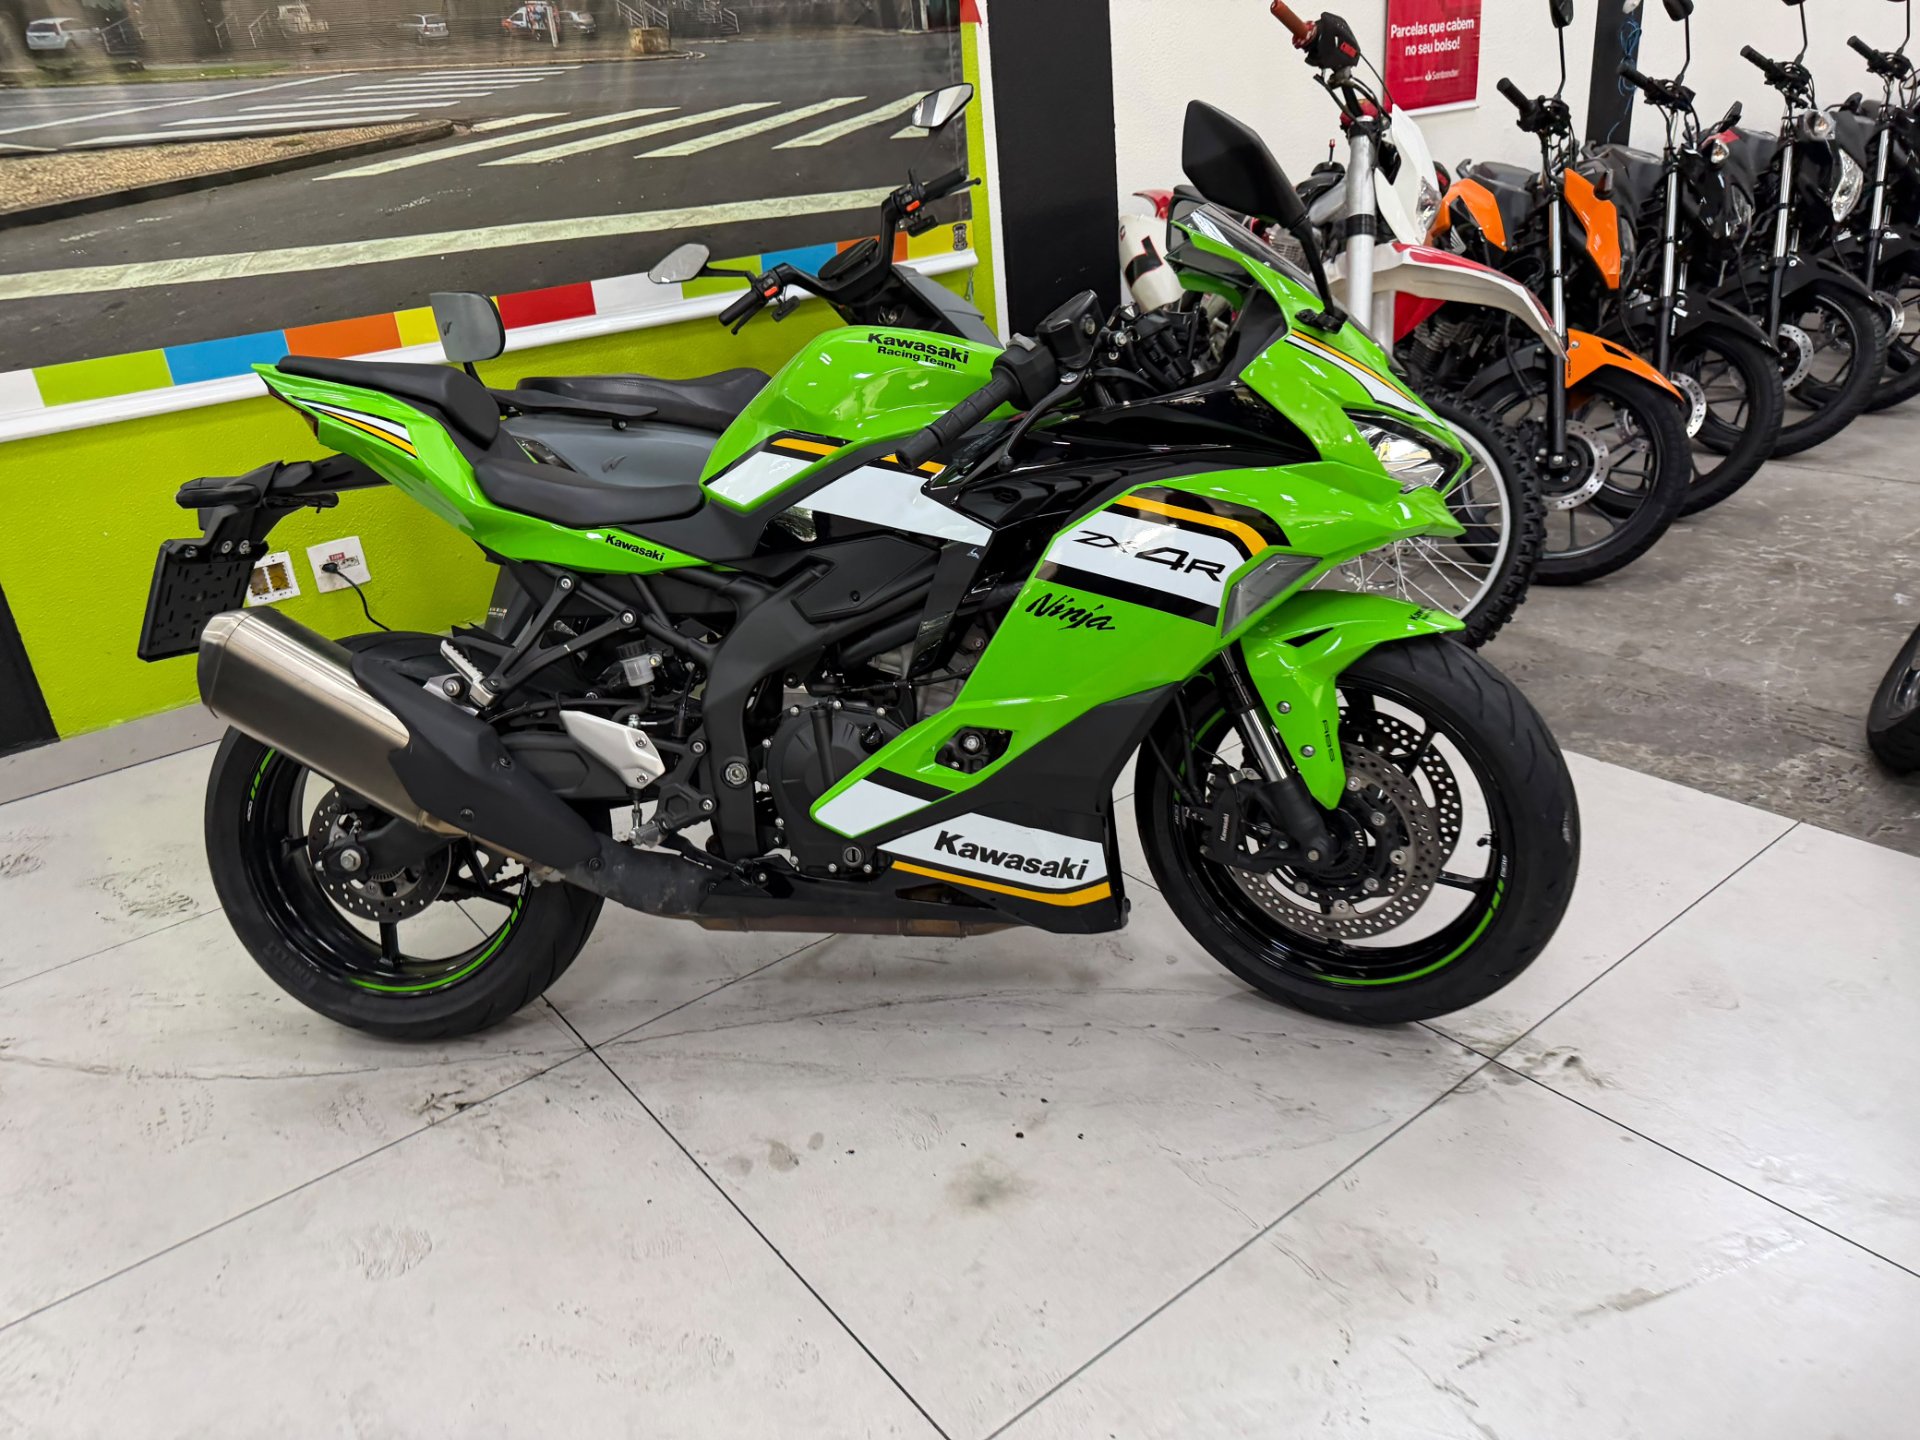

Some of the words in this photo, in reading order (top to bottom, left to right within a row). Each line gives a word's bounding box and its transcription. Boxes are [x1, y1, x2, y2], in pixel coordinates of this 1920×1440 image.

[1390, 21, 1428, 39] Parcelas
[1429, 22, 1446, 37] que
[1446, 17, 1475, 32] cabem
[1405, 45, 1417, 57] no
[1418, 42, 1433, 55] seu
[1434, 36, 1461, 53] bolso!
[867, 333, 970, 364] Kawasaki
[877, 346, 921, 362] Racing
[923, 354, 957, 370] Team
[605, 533, 666, 562] Kawasaki
[1025, 592, 1116, 631] Ninja
[1322, 719, 1336, 763] ABS
[933, 830, 1090, 881] Kawasaki
